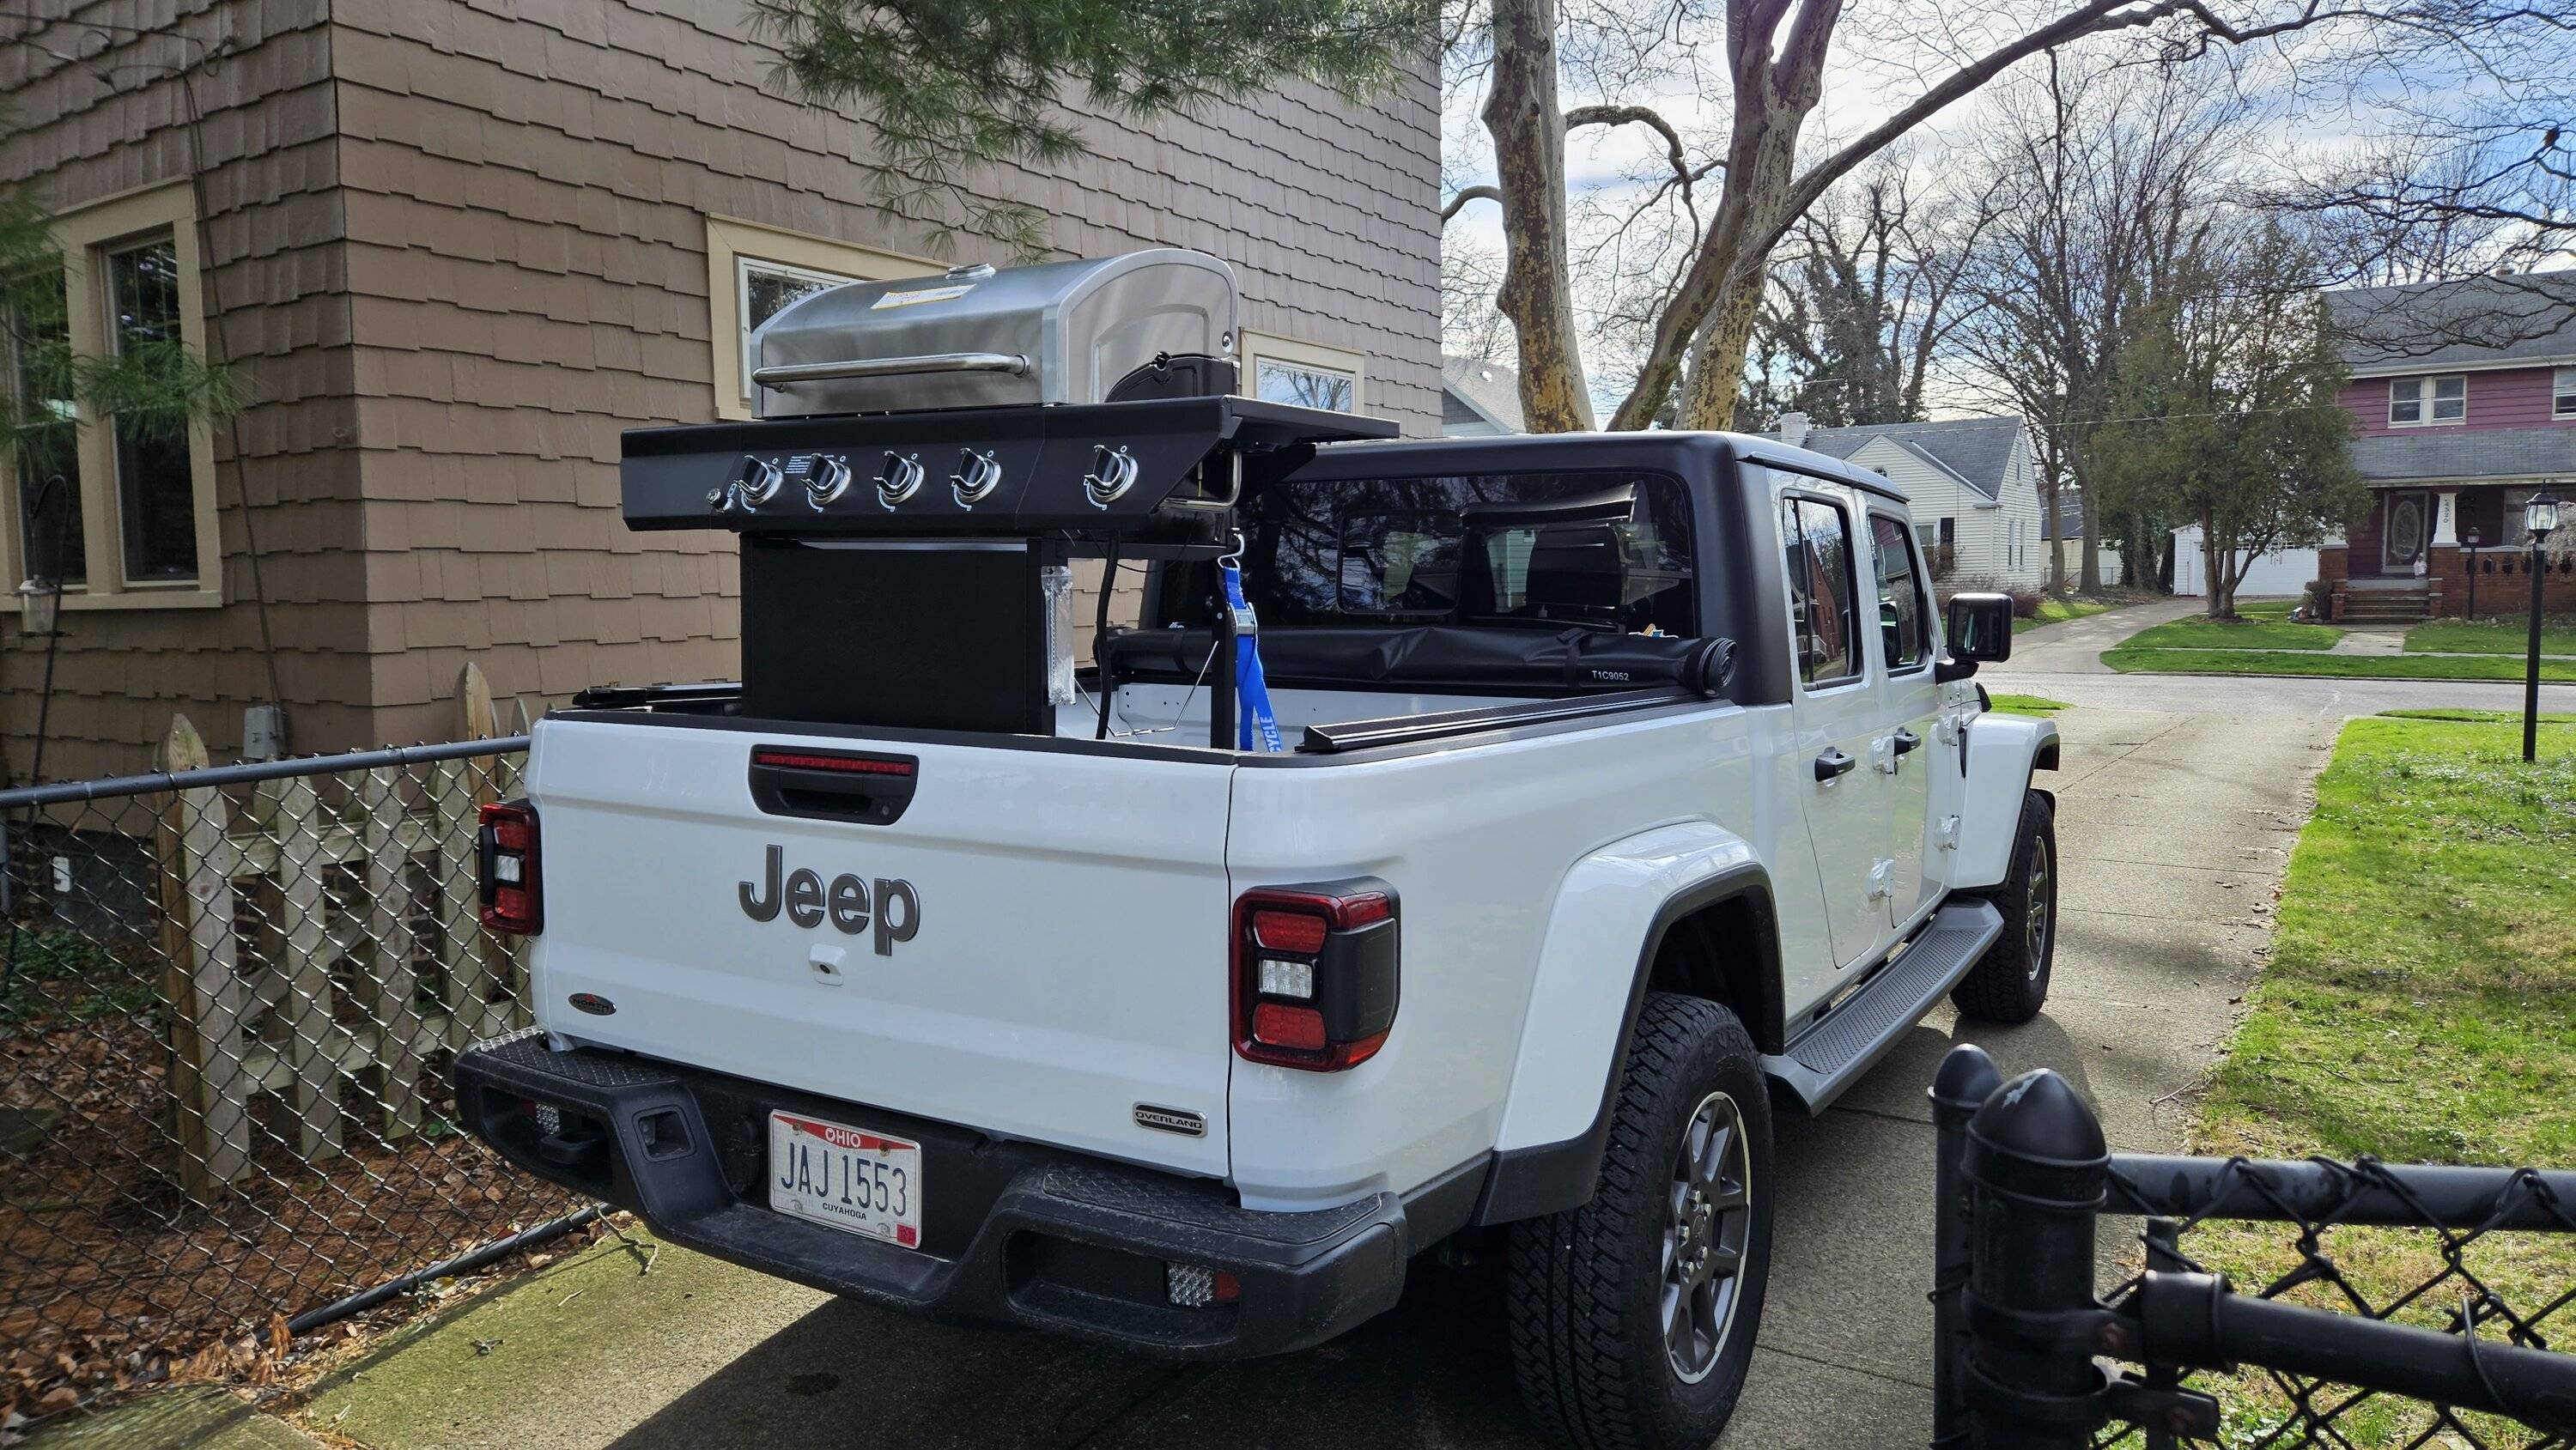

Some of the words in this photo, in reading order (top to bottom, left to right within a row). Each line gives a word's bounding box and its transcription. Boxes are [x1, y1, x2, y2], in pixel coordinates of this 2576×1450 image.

[1591, 670, 1630, 681] T1C9052
[738, 844, 920, 956] Jeep
[1135, 1112, 1202, 1129] OVERLAND
[825, 1127, 861, 1148] OHIO
[781, 1142, 829, 1198] JAJ
[841, 1155, 907, 1216] 1553
[823, 1202, 867, 1221] CUYAHOGA
